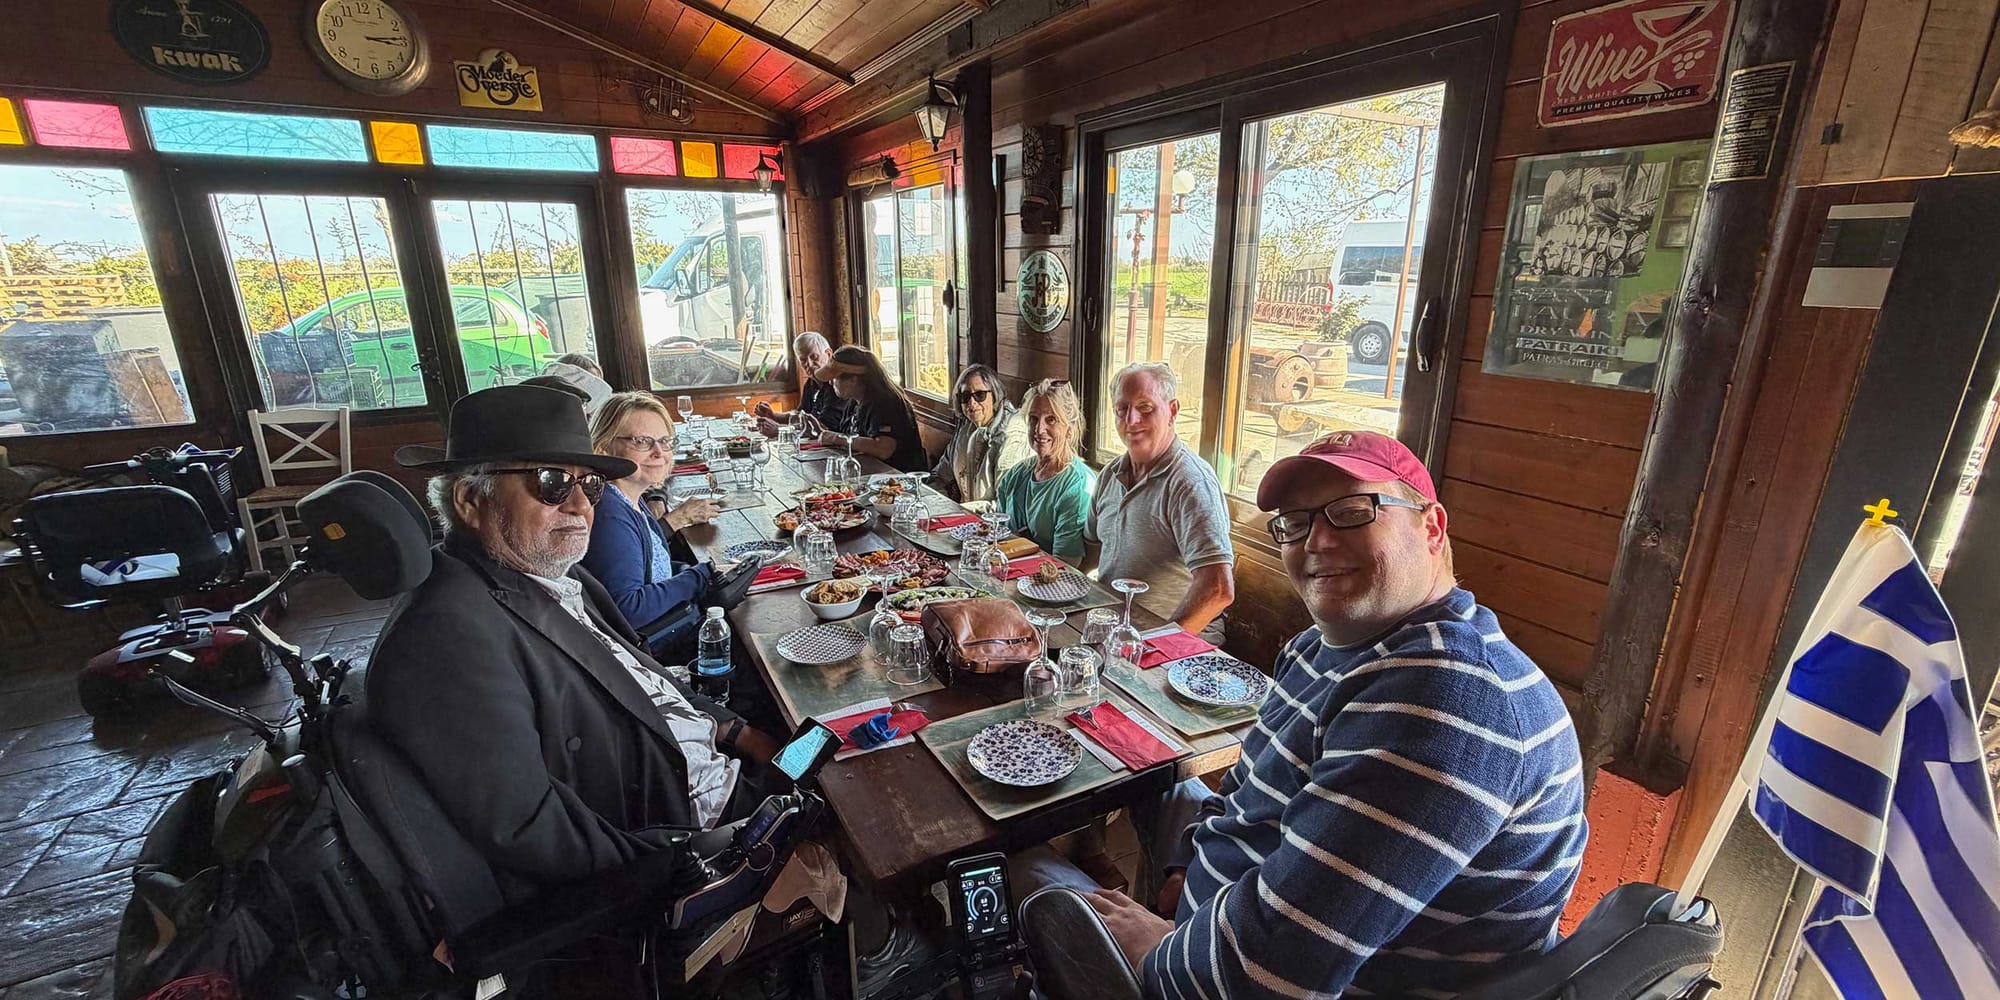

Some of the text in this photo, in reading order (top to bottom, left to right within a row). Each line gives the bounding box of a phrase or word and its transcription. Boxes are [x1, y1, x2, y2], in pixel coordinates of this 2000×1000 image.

[341, 5, 353, 17] 11
[355, 2, 370, 14] 12
[376, 7, 384, 19] 1
[331, 15, 344, 28] 10
[391, 20, 400, 32] 2
[328, 29, 337, 42] 9
[339, 46, 348, 58] 8
[397, 51, 404, 63] 4
[353, 57, 361, 70] 7
[370, 62, 379, 74] 6
[388, 60, 395, 72] 5
[1556, 33, 1648, 97] Wine
[1555, 88, 1692, 115] PREMIUM QUALITY WINES
[1520, 325, 1561, 336] DRY
